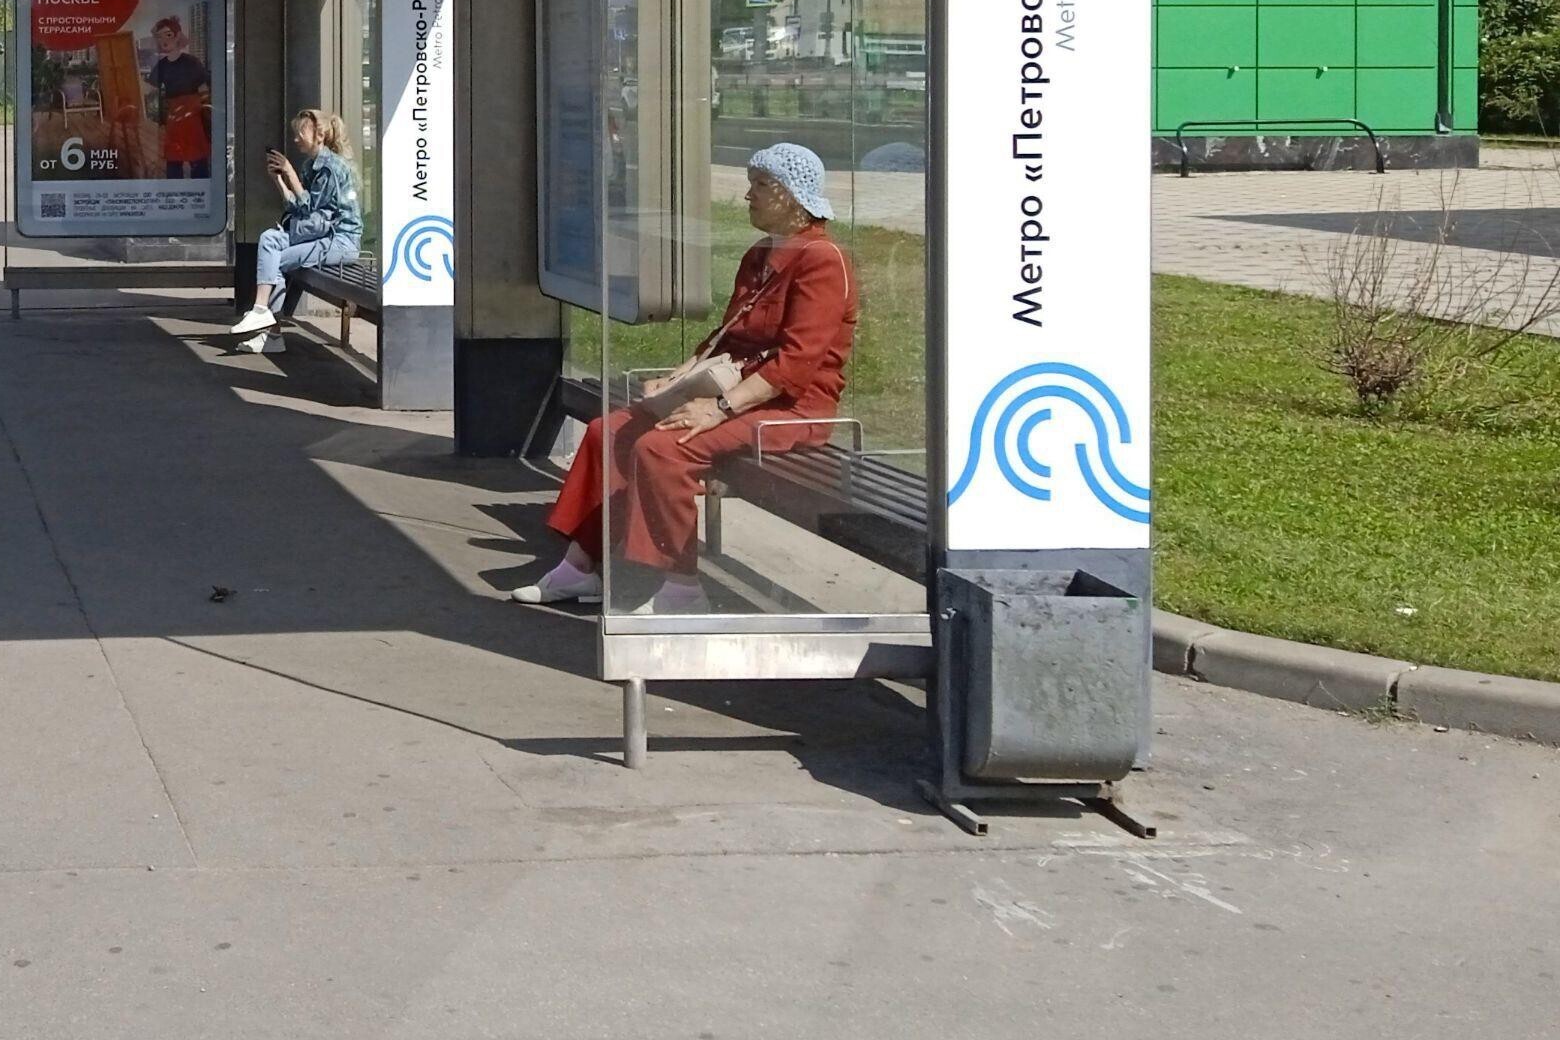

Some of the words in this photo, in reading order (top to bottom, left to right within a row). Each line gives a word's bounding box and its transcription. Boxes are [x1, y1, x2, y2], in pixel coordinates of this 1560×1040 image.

[38, 26, 92, 34] ТЕРРАСАМИ
[46, 16, 116, 25] ПРОСТОРНЫМИ
[432, 34, 443, 70] Metro
[39, 160, 58, 170] ОТ
[60, 136, 86, 171] 6
[90, 149, 118, 159] МЛН
[90, 160, 119, 170] РУБ.
[412, 138, 431, 201] Метро
[1013, 195, 1051, 328] Метро
